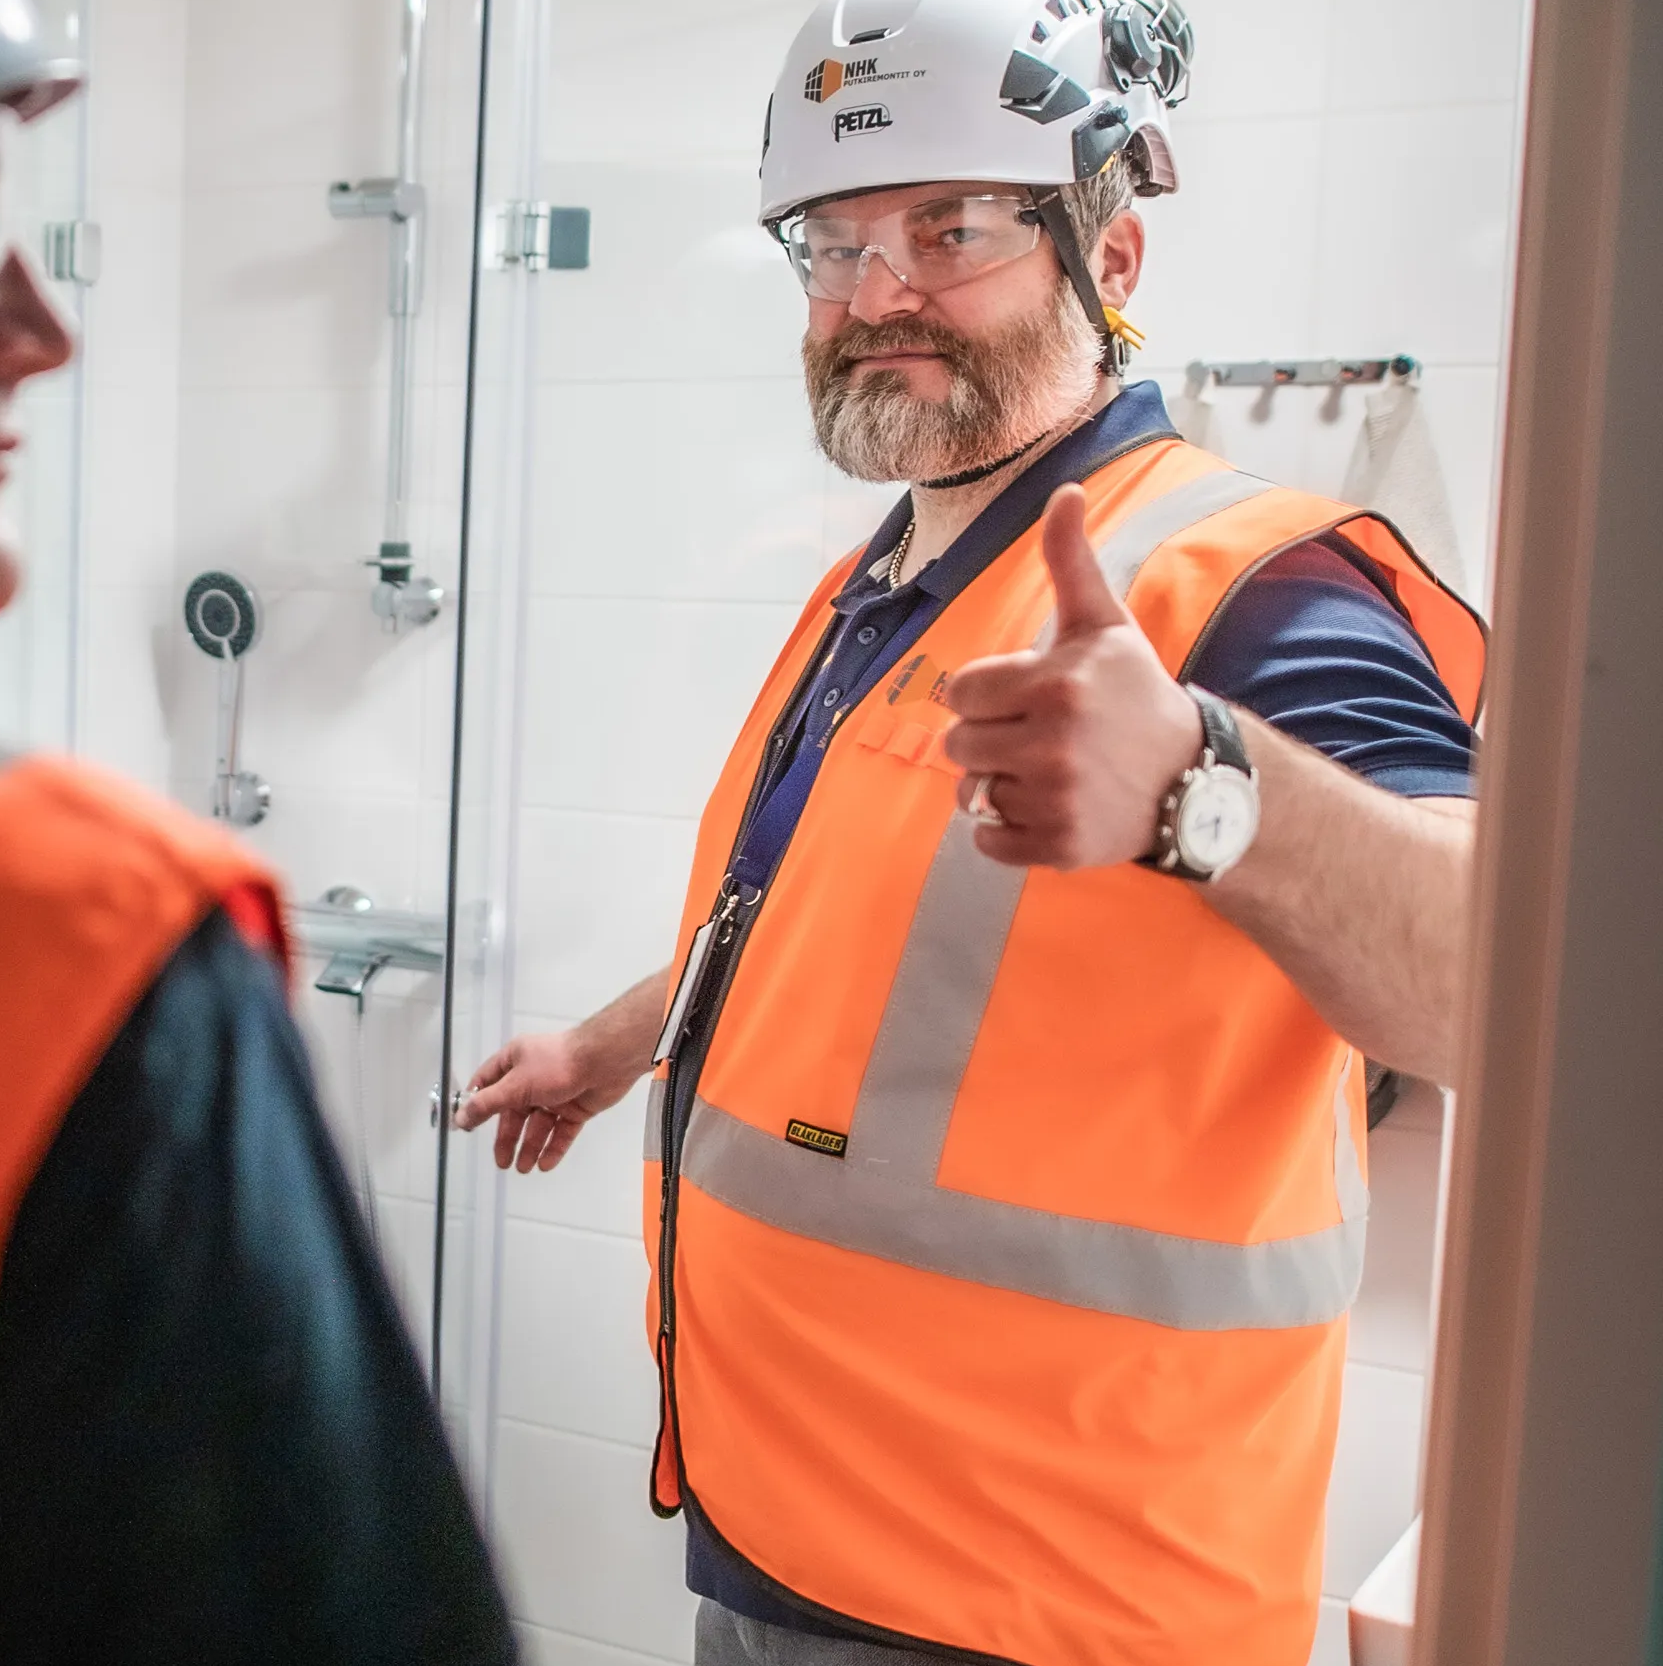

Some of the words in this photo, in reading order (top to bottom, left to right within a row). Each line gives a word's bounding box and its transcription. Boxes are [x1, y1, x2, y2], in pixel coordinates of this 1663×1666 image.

[843, 71, 910, 87] PUTKIREMONTIT
[913, 69, 927, 78] OY
[844, 58, 878, 79] NHK
[835, 108, 893, 143] PETZL
